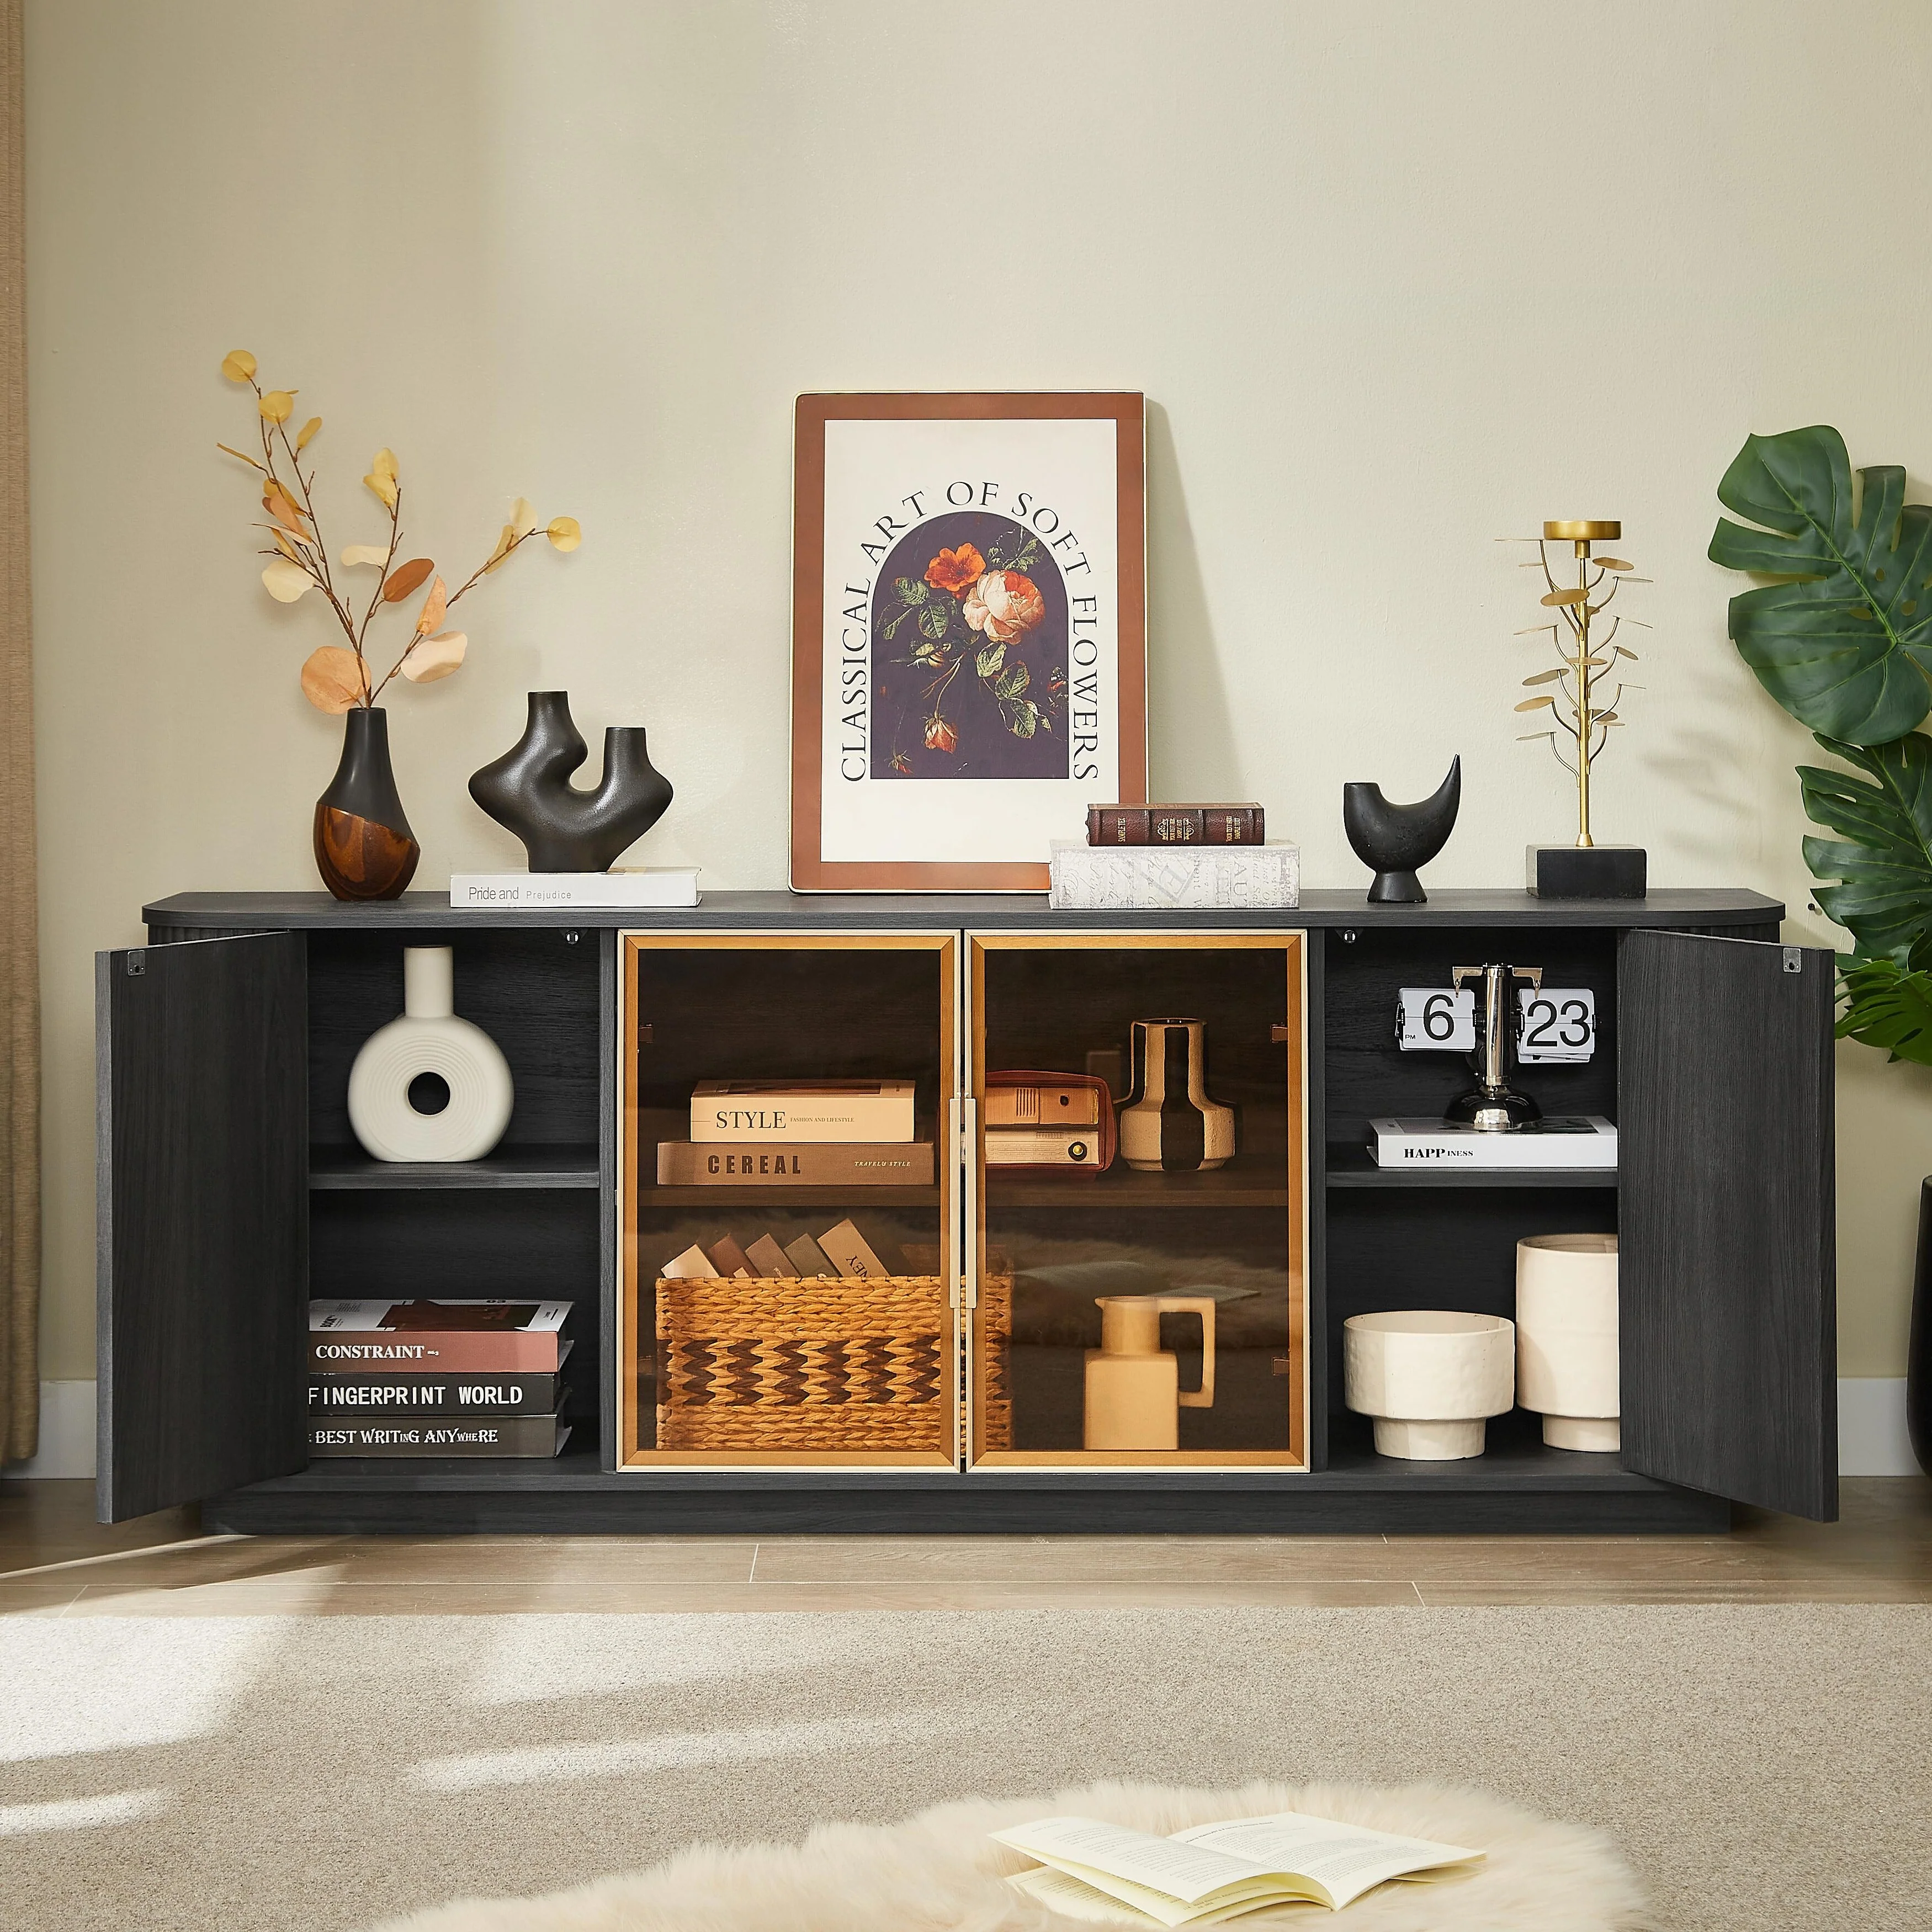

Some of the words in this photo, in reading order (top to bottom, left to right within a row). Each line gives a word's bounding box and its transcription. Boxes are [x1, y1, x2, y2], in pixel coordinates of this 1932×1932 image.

[842, 577, 871, 782] CLASSICAL
[860, 490, 927, 566] ART
[947, 481, 999, 506] OF
[1011, 492, 1091, 576] SOFT
[1072, 595, 1098, 780] FLOWERS
[469, 887, 496, 900] Pride
[498, 887, 519, 900] and
[526, 890, 572, 901] Prejudice
[1423, 994, 1456, 1041] 6
[1526, 1000, 1591, 1047] 23
[716, 1111, 787, 1129] STYLE
[707, 1155, 802, 1174] CEREAL
[315, 1345, 424, 1358] CONSTRAINT
[309, 1387, 446, 1405] FINGERPRINT
[458, 1386, 523, 1404] WORLD
[315, 1430, 357, 1444] BEST
